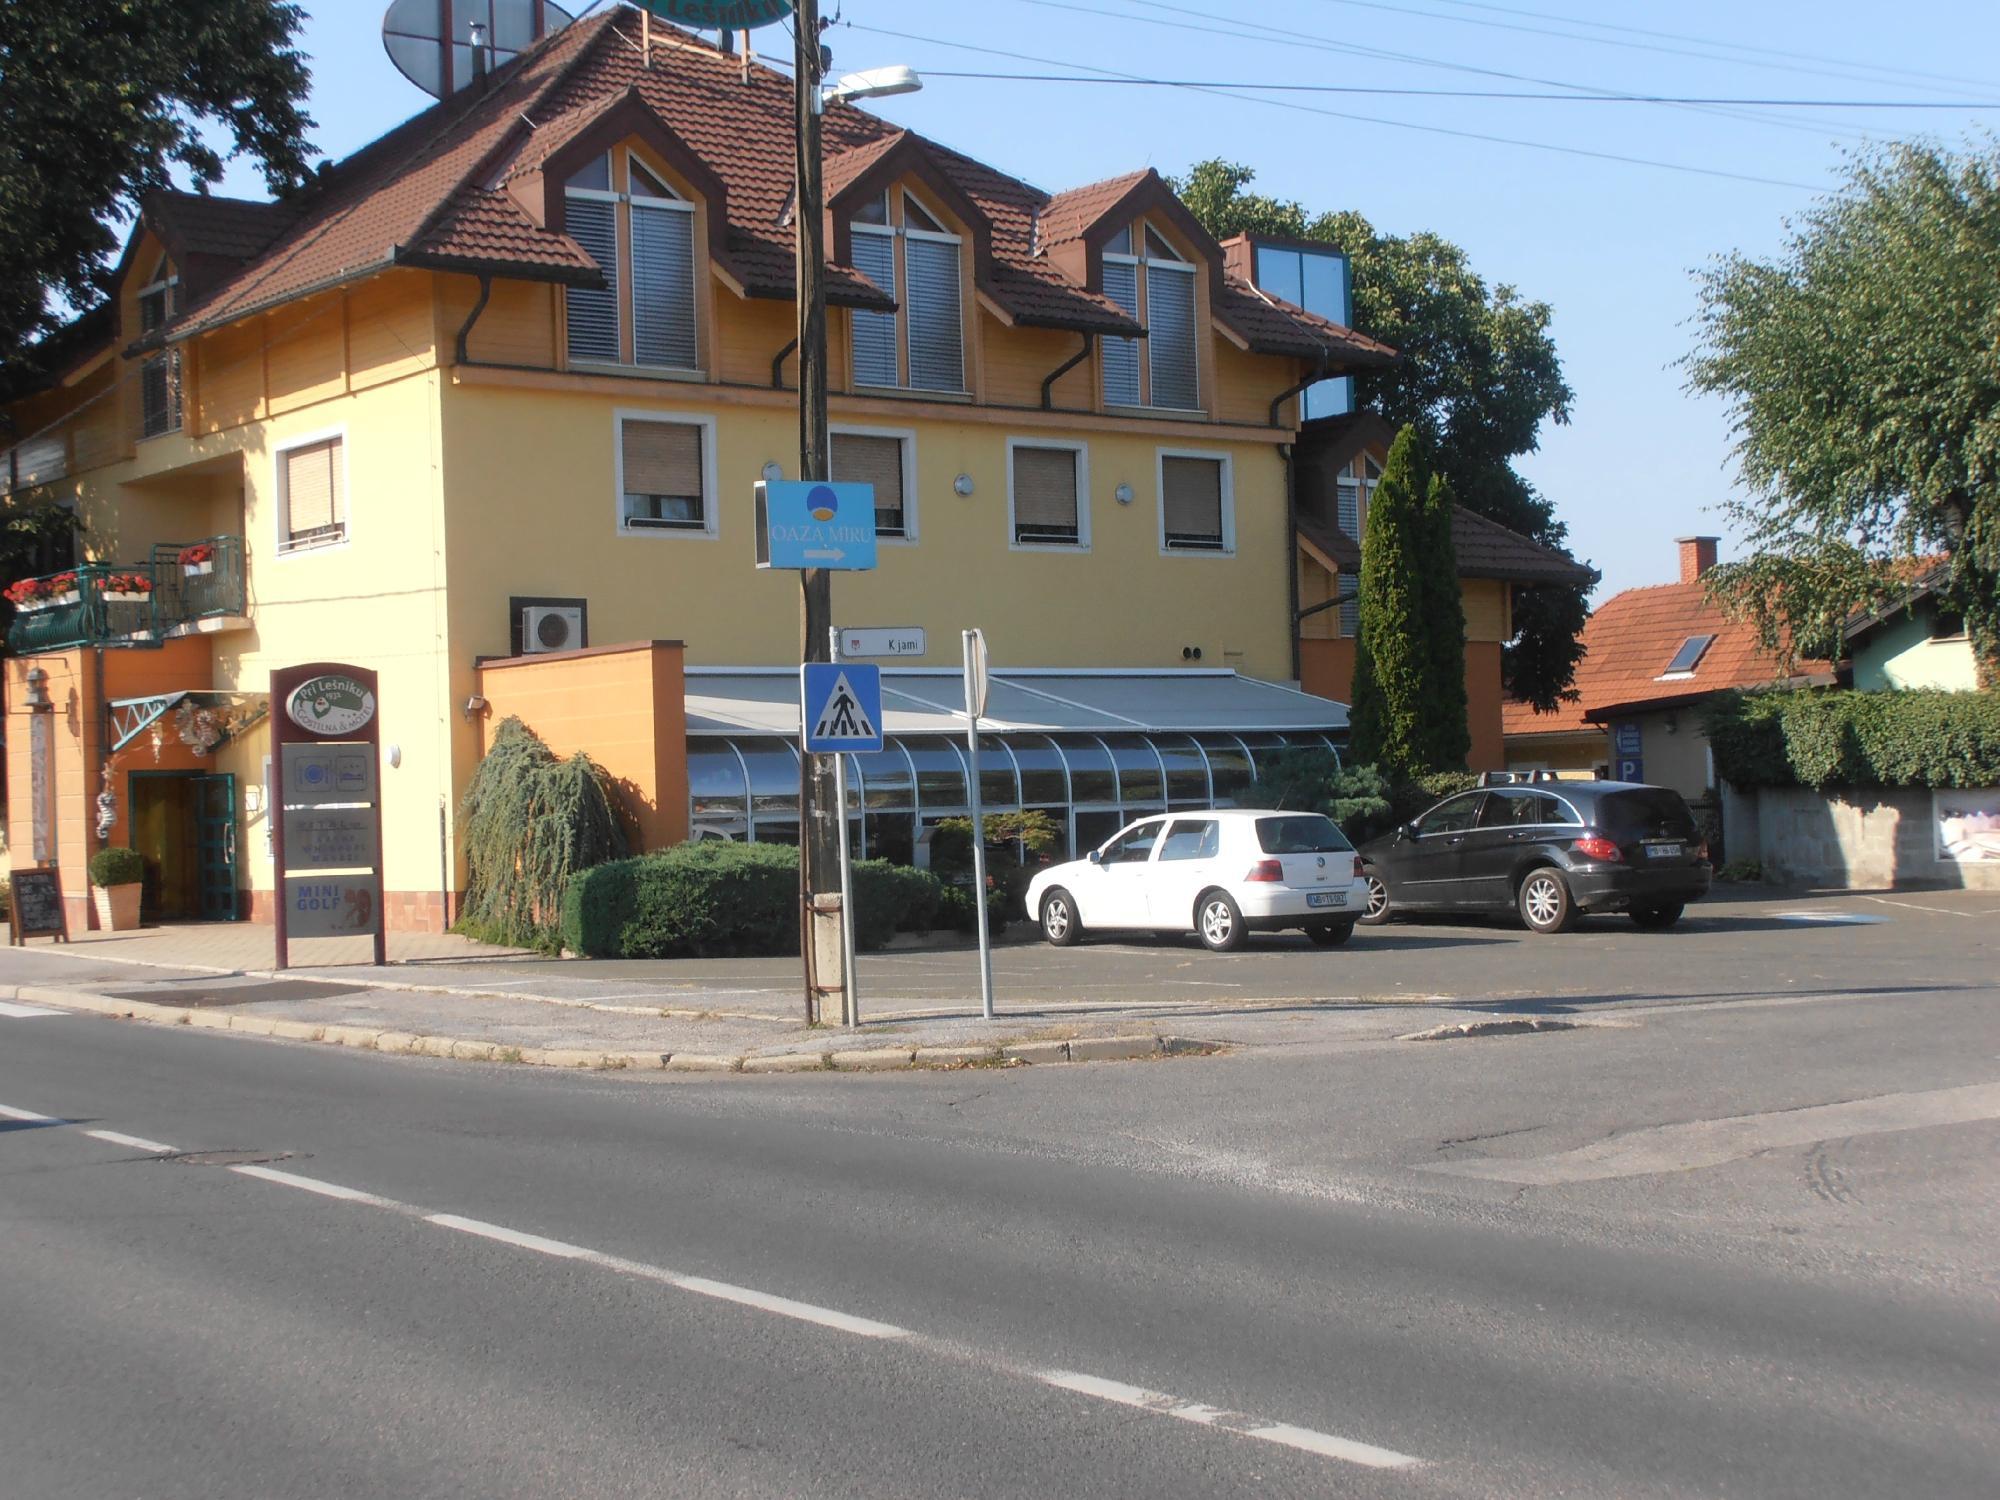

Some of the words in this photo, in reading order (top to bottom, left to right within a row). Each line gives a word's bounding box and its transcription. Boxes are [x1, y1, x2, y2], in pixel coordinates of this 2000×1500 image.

[771, 524, 825, 542] OAZA
[828, 526, 872, 543] MIRU
[888, 639, 896, 650] K
[897, 640, 918, 653] jami
[300, 683, 317, 699] Pri
[318, 679, 364, 698] Lešniku
[296, 709, 338, 732] GOSTILNA
[339, 721, 348, 731] &
[348, 705, 373, 729] MOTEL
[1622, 760, 1636, 781] P
[297, 884, 339, 898] MINI
[297, 897, 340, 911] GOLF
